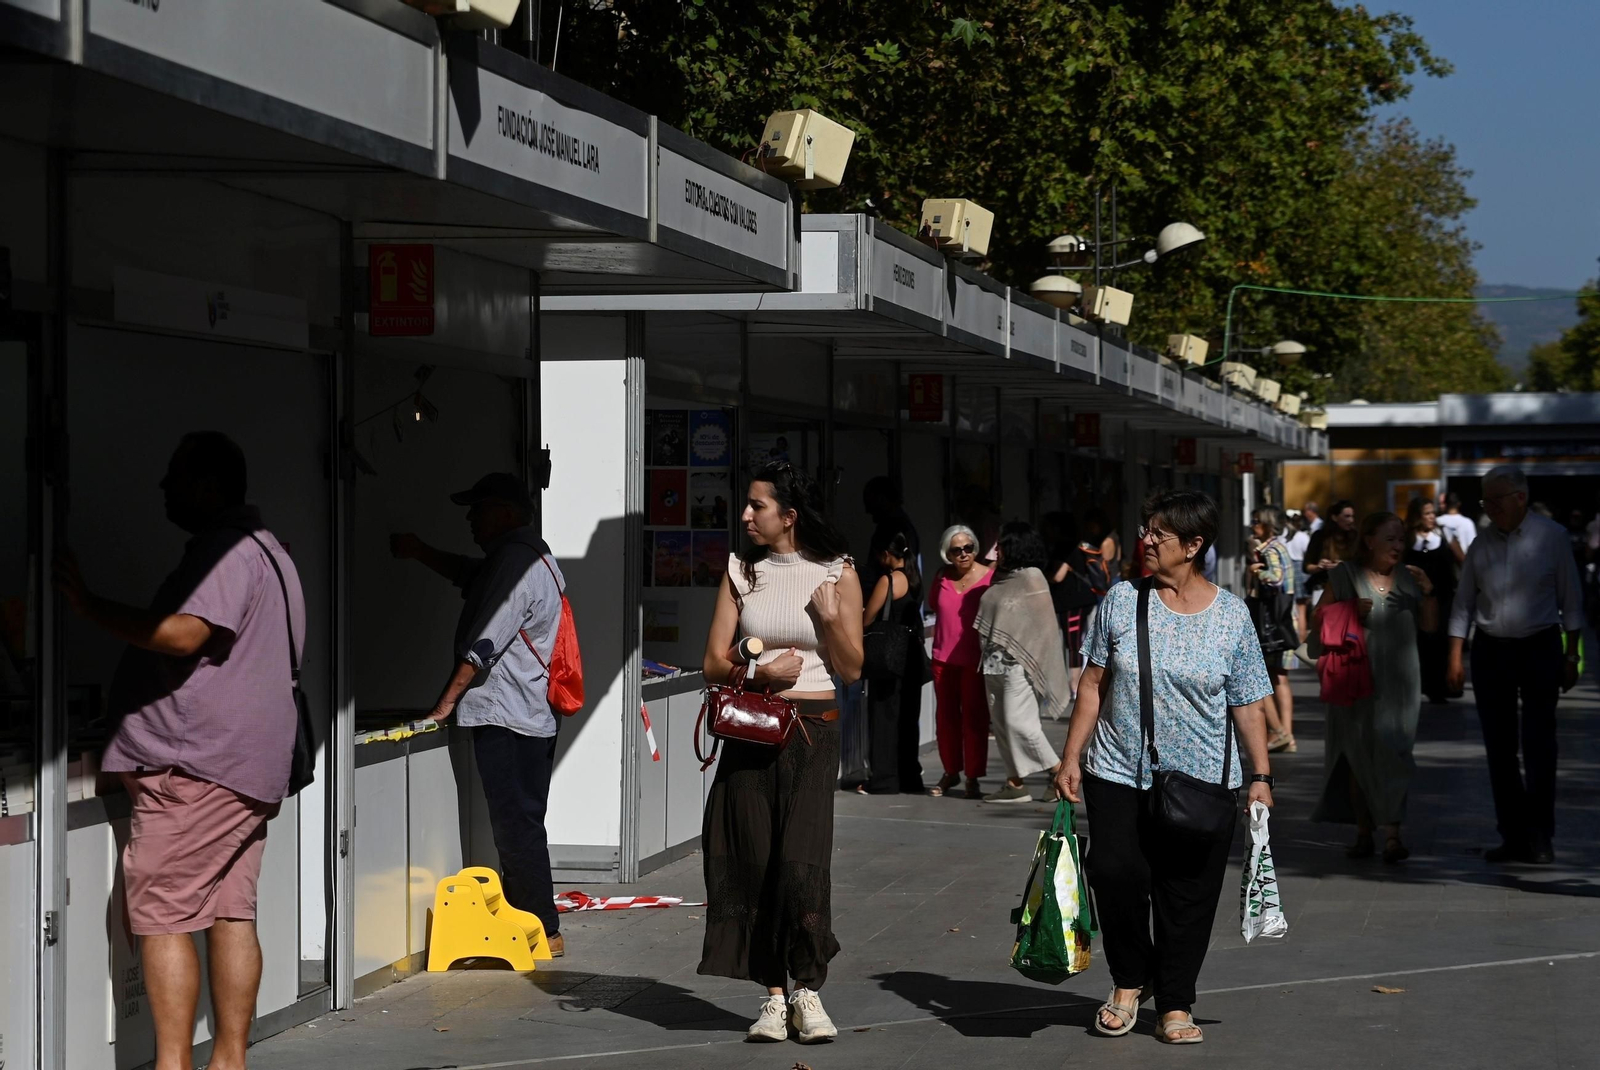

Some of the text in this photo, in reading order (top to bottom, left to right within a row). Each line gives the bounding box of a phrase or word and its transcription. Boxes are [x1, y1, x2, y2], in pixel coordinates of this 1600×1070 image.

[498, 105, 600, 174] FUNDACIÓN JOSÉ MANUEL LARA
[739, 204, 758, 235] VALORES
[375, 316, 429, 327] EXTINTOR
[125, 962, 139, 983] JOSÉ
[125, 1000, 140, 1019] LARA
